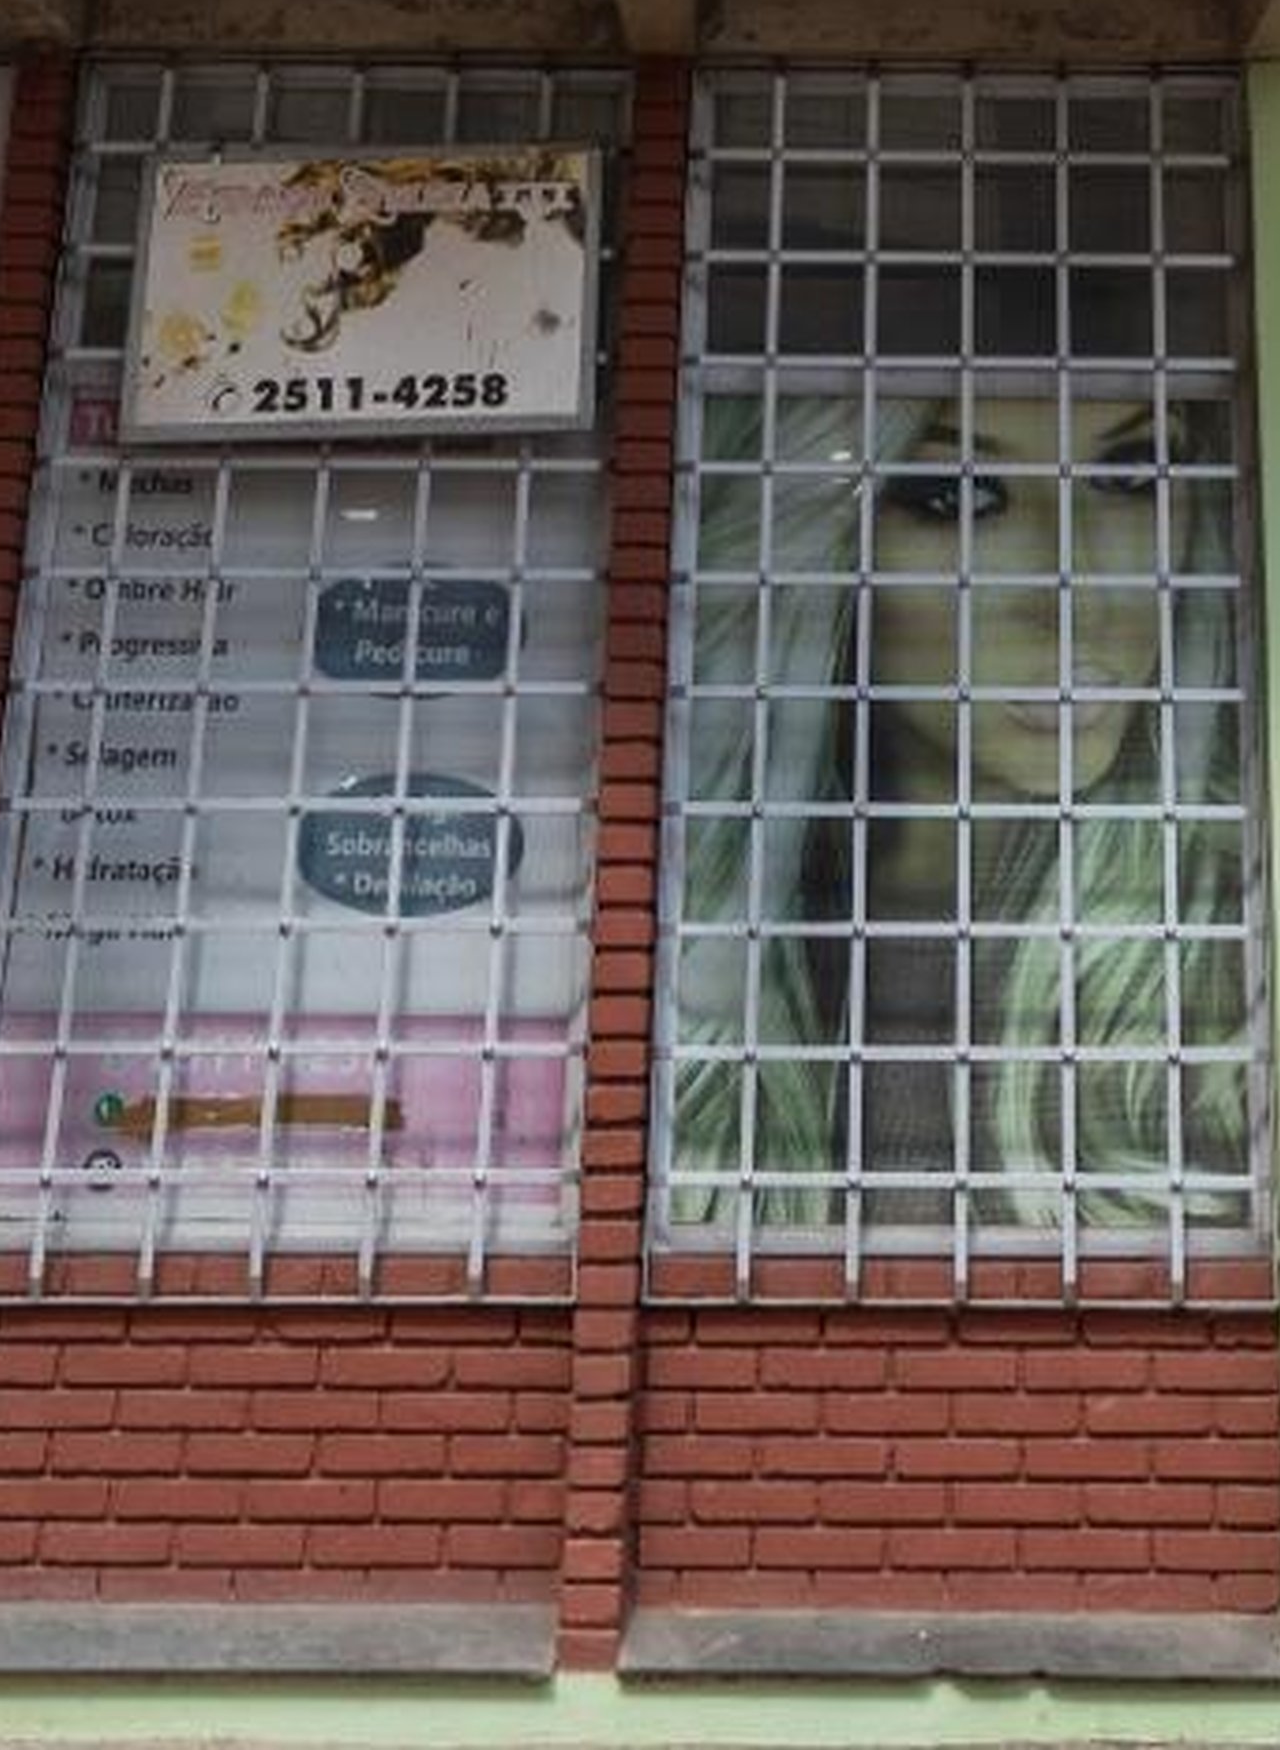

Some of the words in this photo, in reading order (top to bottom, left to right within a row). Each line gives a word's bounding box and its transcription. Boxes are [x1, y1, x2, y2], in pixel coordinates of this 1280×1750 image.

[253, 373, 509, 413] 2511-4258
[99, 470, 192, 495] Mchas
[92, 522, 215, 553] Cloração
[353, 598, 476, 623] Mancure
[79, 632, 228, 661] Progressia
[354, 639, 470, 666] Pedcure
[52, 856, 199, 887] Hdratação
